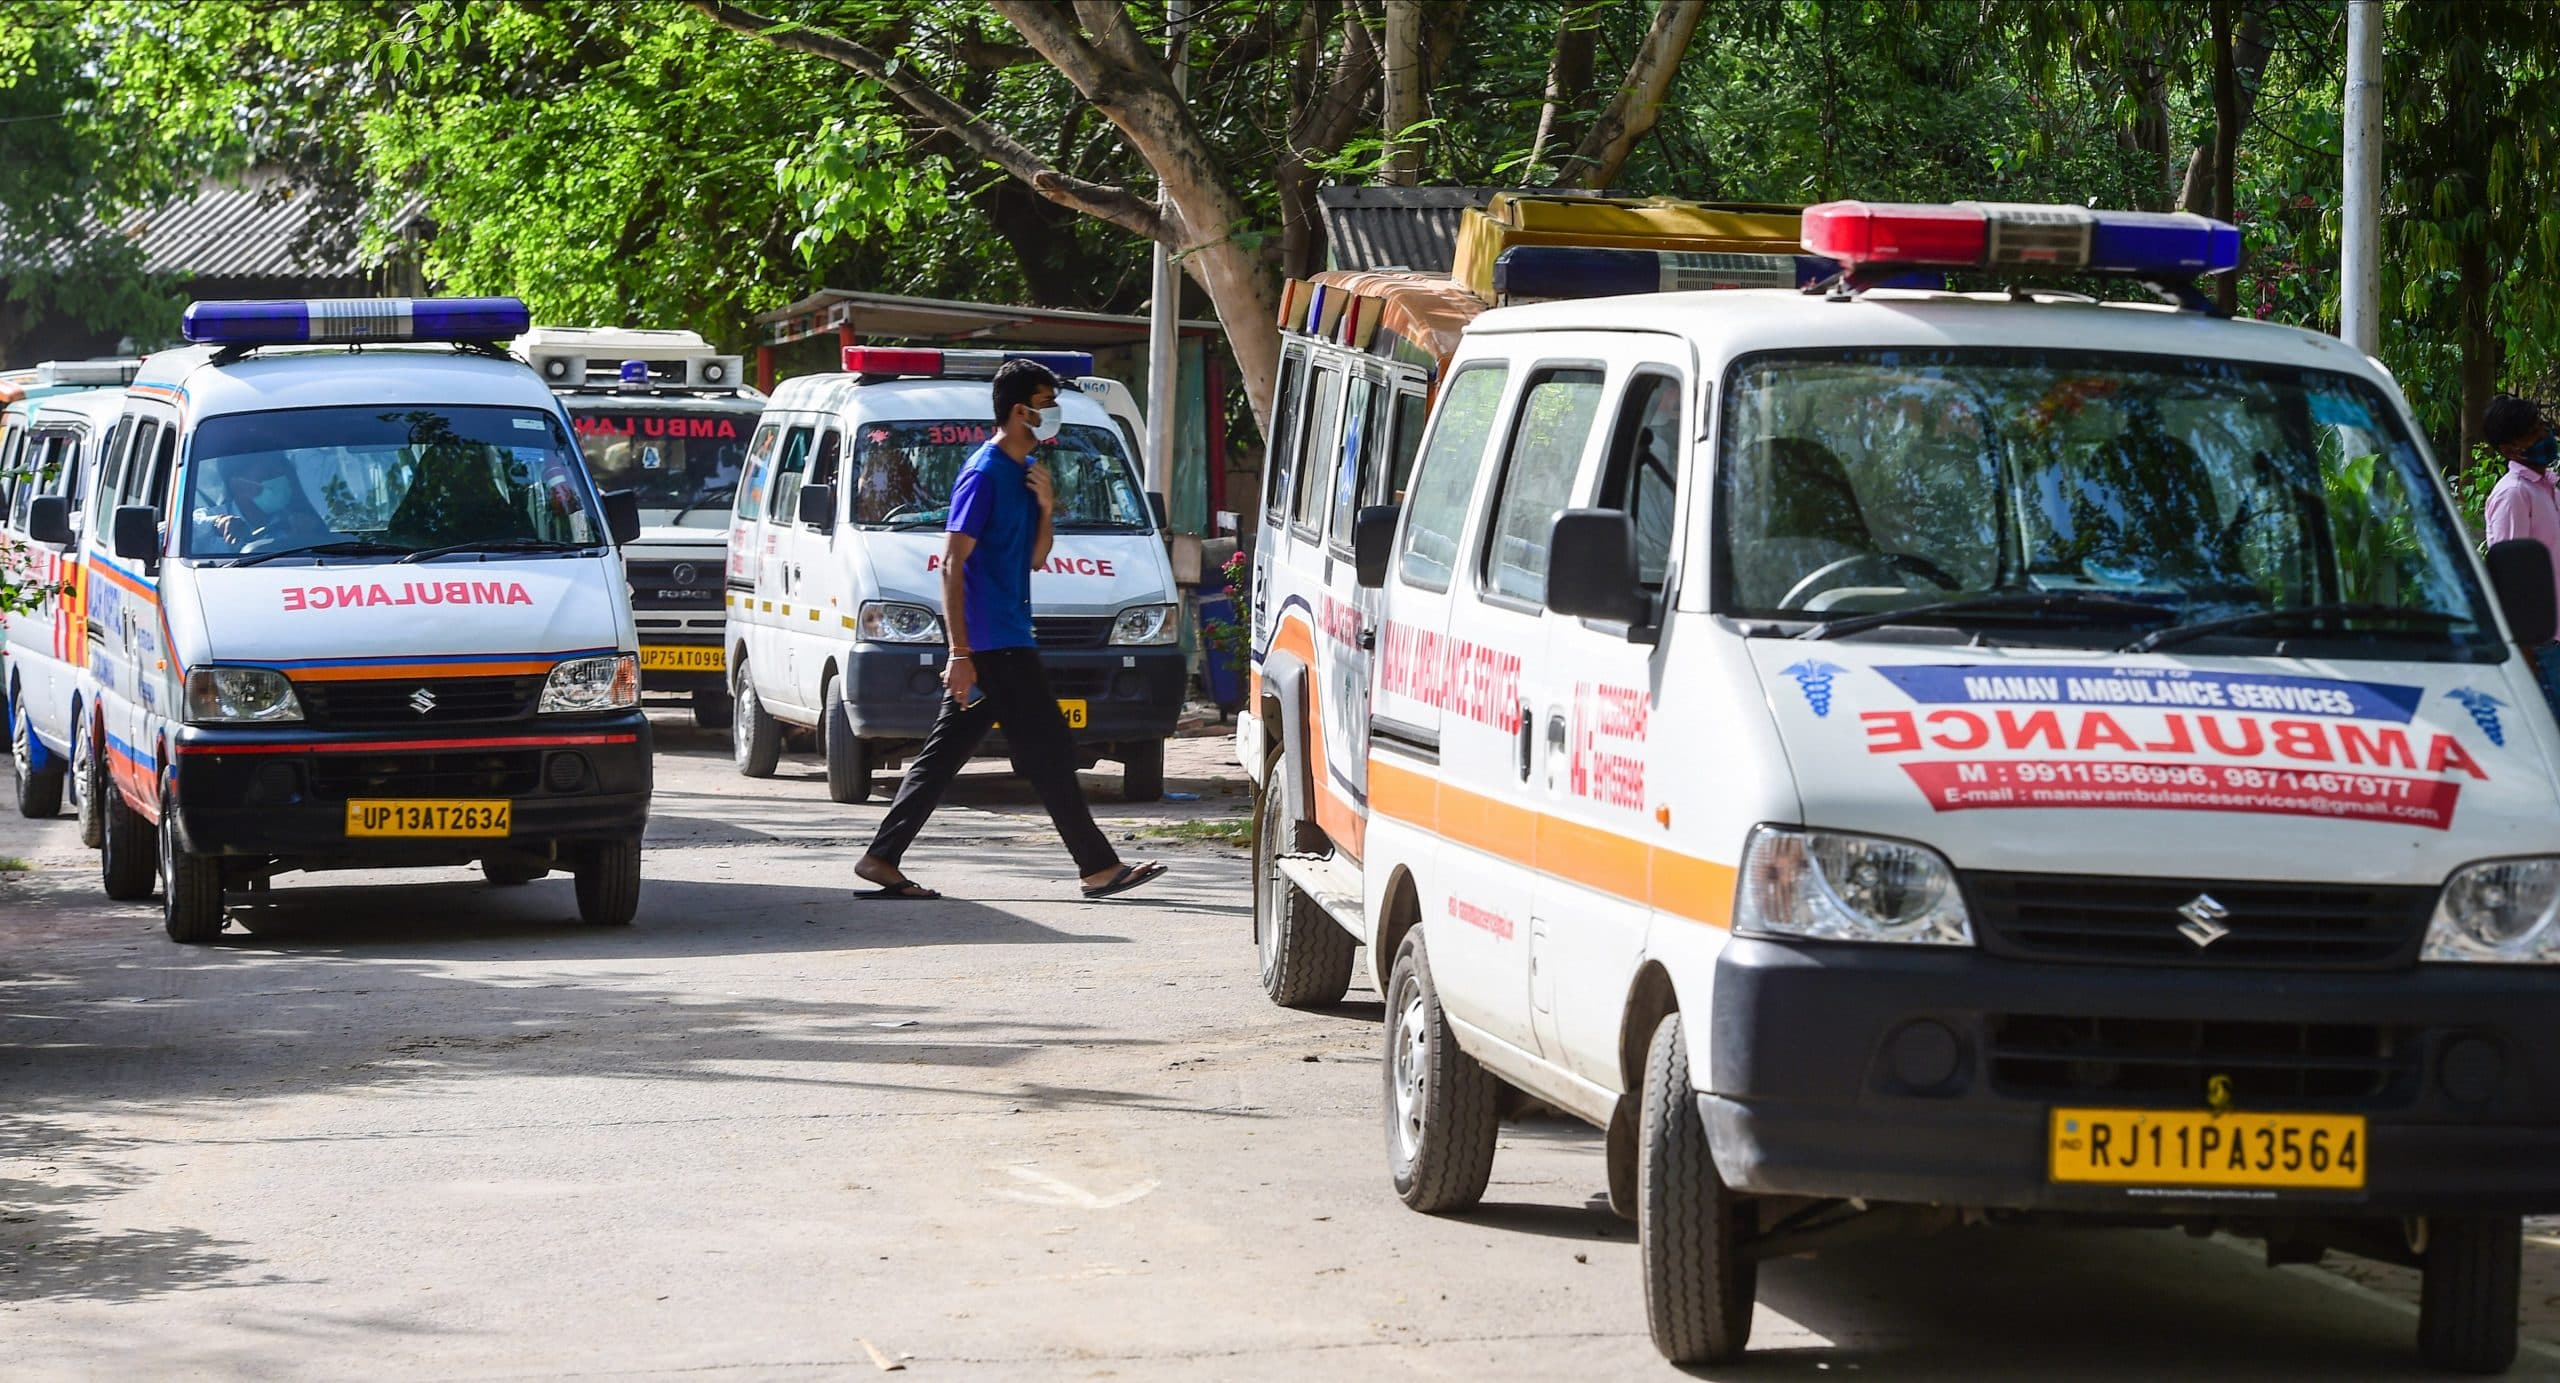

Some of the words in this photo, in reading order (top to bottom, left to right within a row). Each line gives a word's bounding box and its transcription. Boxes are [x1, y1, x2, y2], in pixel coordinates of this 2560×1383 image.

[1411, 628, 1473, 716] AMBULANCE
[1472, 643, 1522, 736] SERVICES
[1963, 677, 2060, 701] MANAV
[2067, 678, 2227, 707] AMBULANCE
[2228, 683, 2355, 715] SERVICES
[2016, 764, 2218, 788] 9911556996,
[2224, 768, 2411, 798] 9871467977
[364, 807, 506, 830] UP13AT2634
[1944, 787, 2014, 803] E-mail
[2032, 788, 2440, 820] manavambulanceservices@gmail.com
[2089, 1122, 2358, 1174] RJ11PA3564
